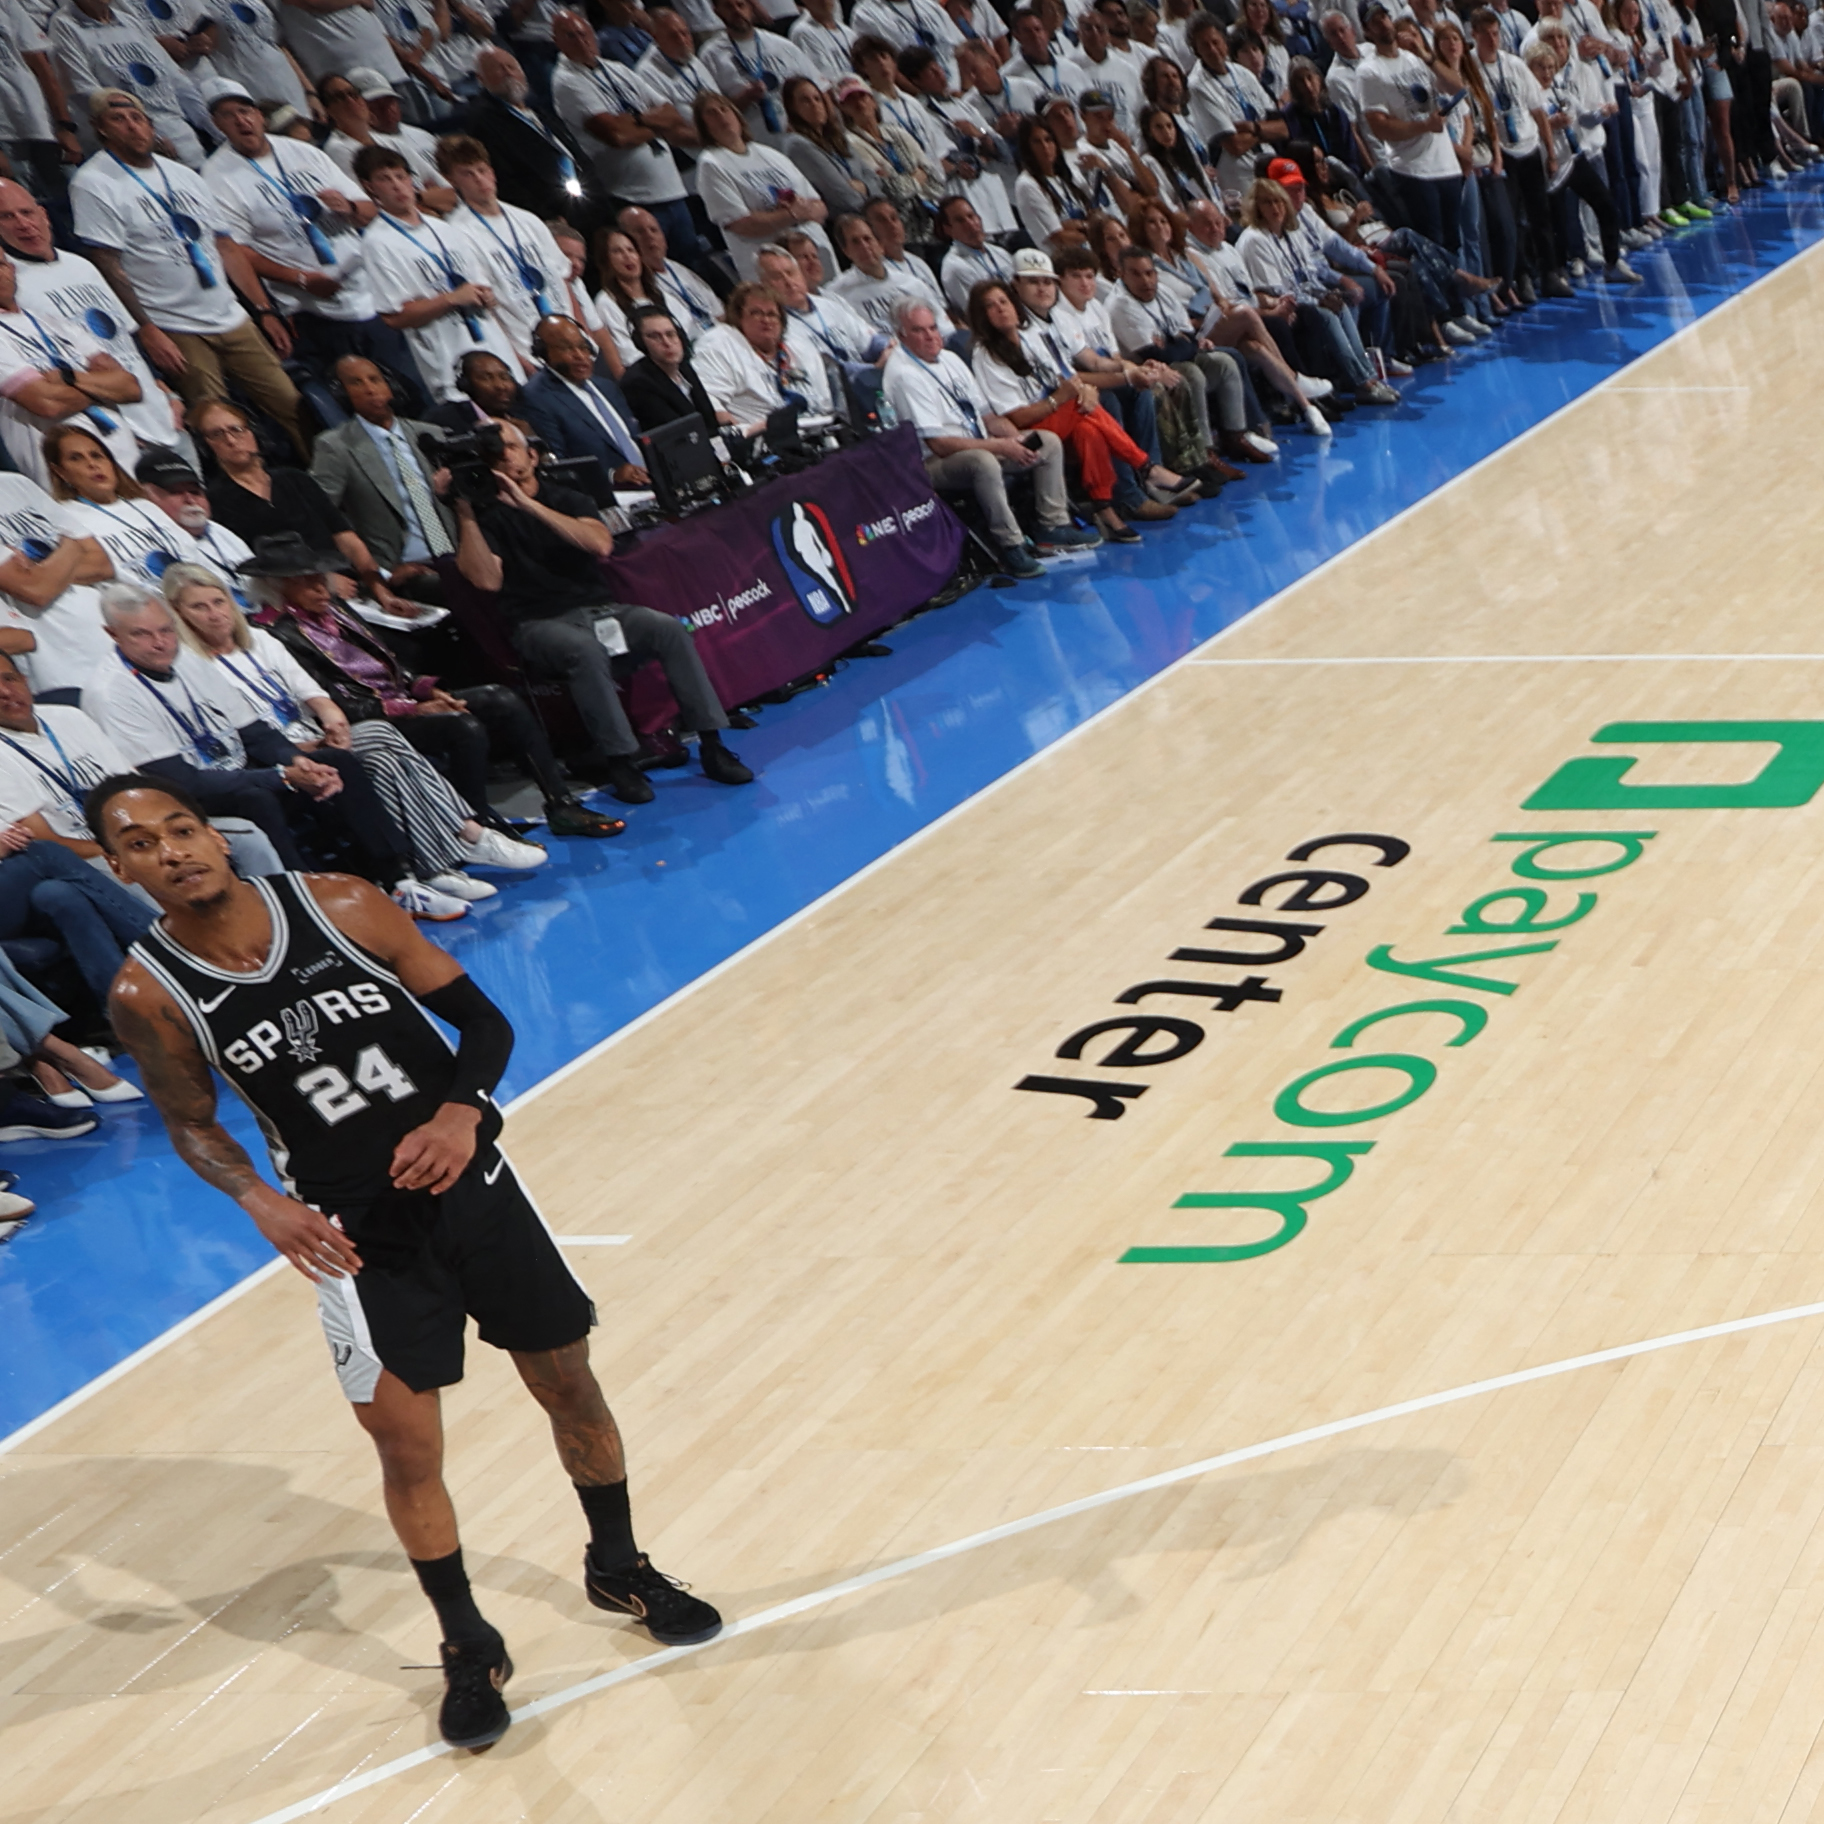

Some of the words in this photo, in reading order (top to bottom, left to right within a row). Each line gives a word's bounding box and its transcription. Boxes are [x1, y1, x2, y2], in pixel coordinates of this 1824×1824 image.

[690, 604, 724, 629] NBC
[727, 578, 773, 620] peacock
[1012, 832, 1411, 1121] center
[224, 982, 391, 1073] SPURS
[1115, 830, 1659, 1264] paycom
[294, 1043, 419, 1126] 24
